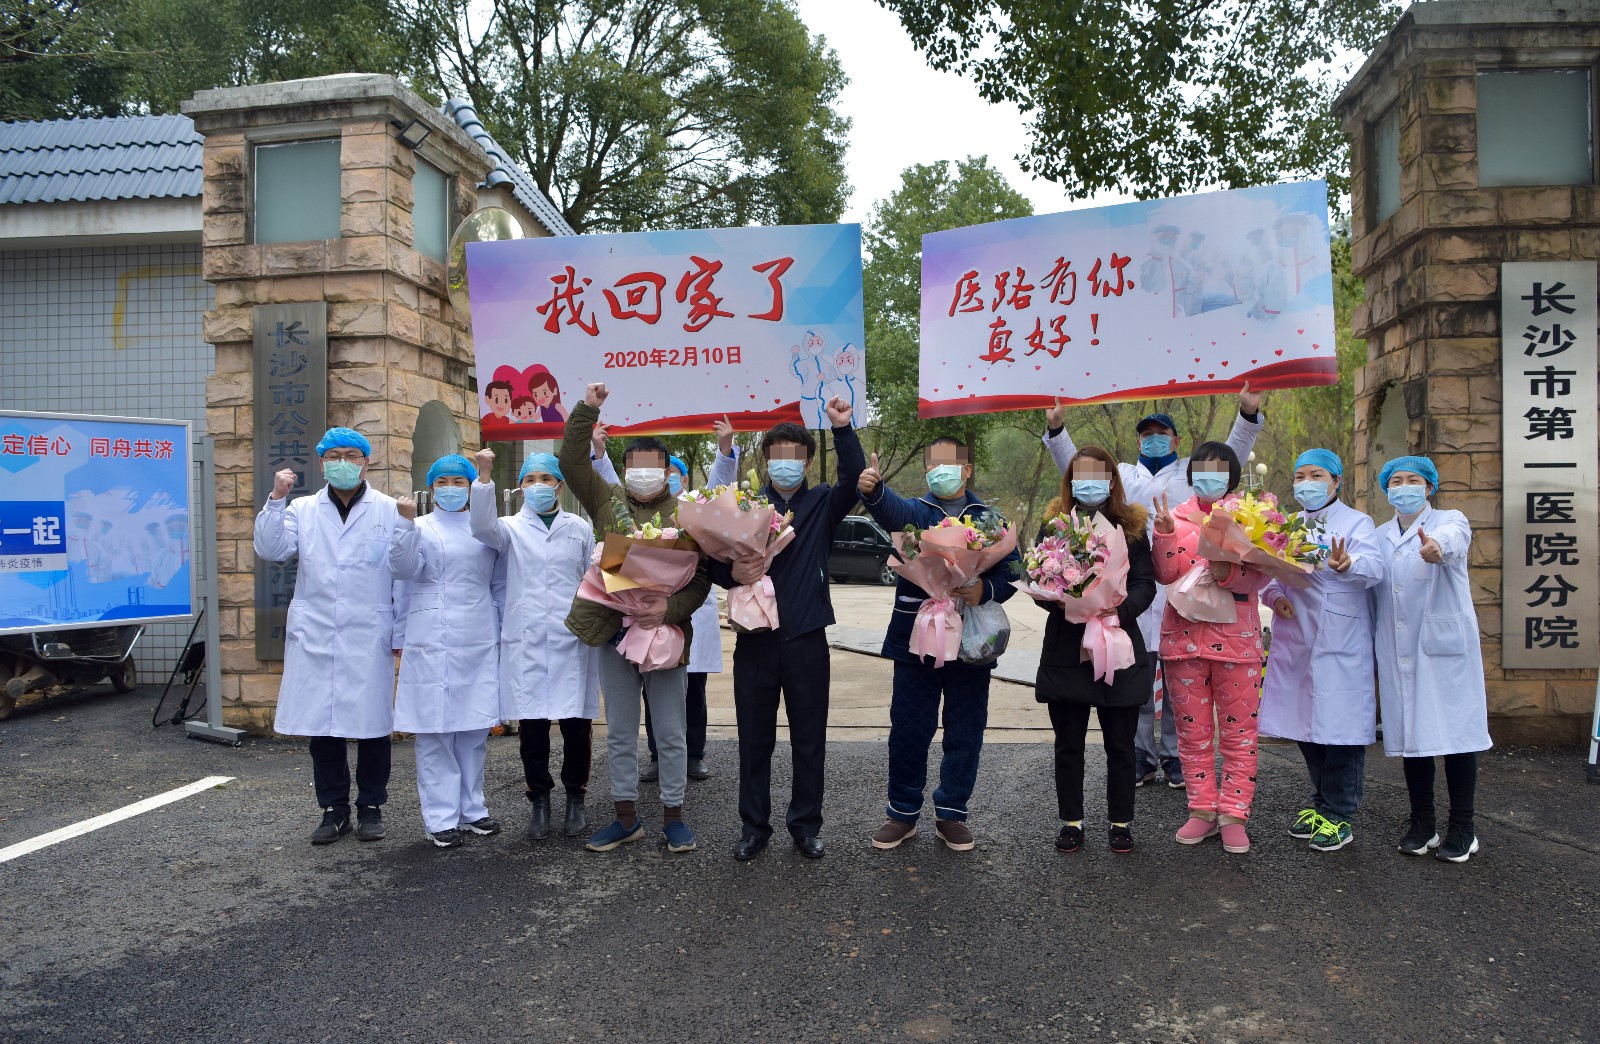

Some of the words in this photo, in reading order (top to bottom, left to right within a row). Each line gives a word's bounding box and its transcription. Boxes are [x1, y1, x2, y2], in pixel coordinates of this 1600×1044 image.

[536, 255, 795, 337] 我回家了
[949, 253, 1135, 318] 医路有你
[604, 345, 742, 369] 2020年2月10日
[979, 312, 1100, 364] 真好！
[90, 437, 174, 459] 同舟共济
[1521, 281, 1580, 650] 长沙市第一医院分院
[0, 516, 61, 546] 一起
